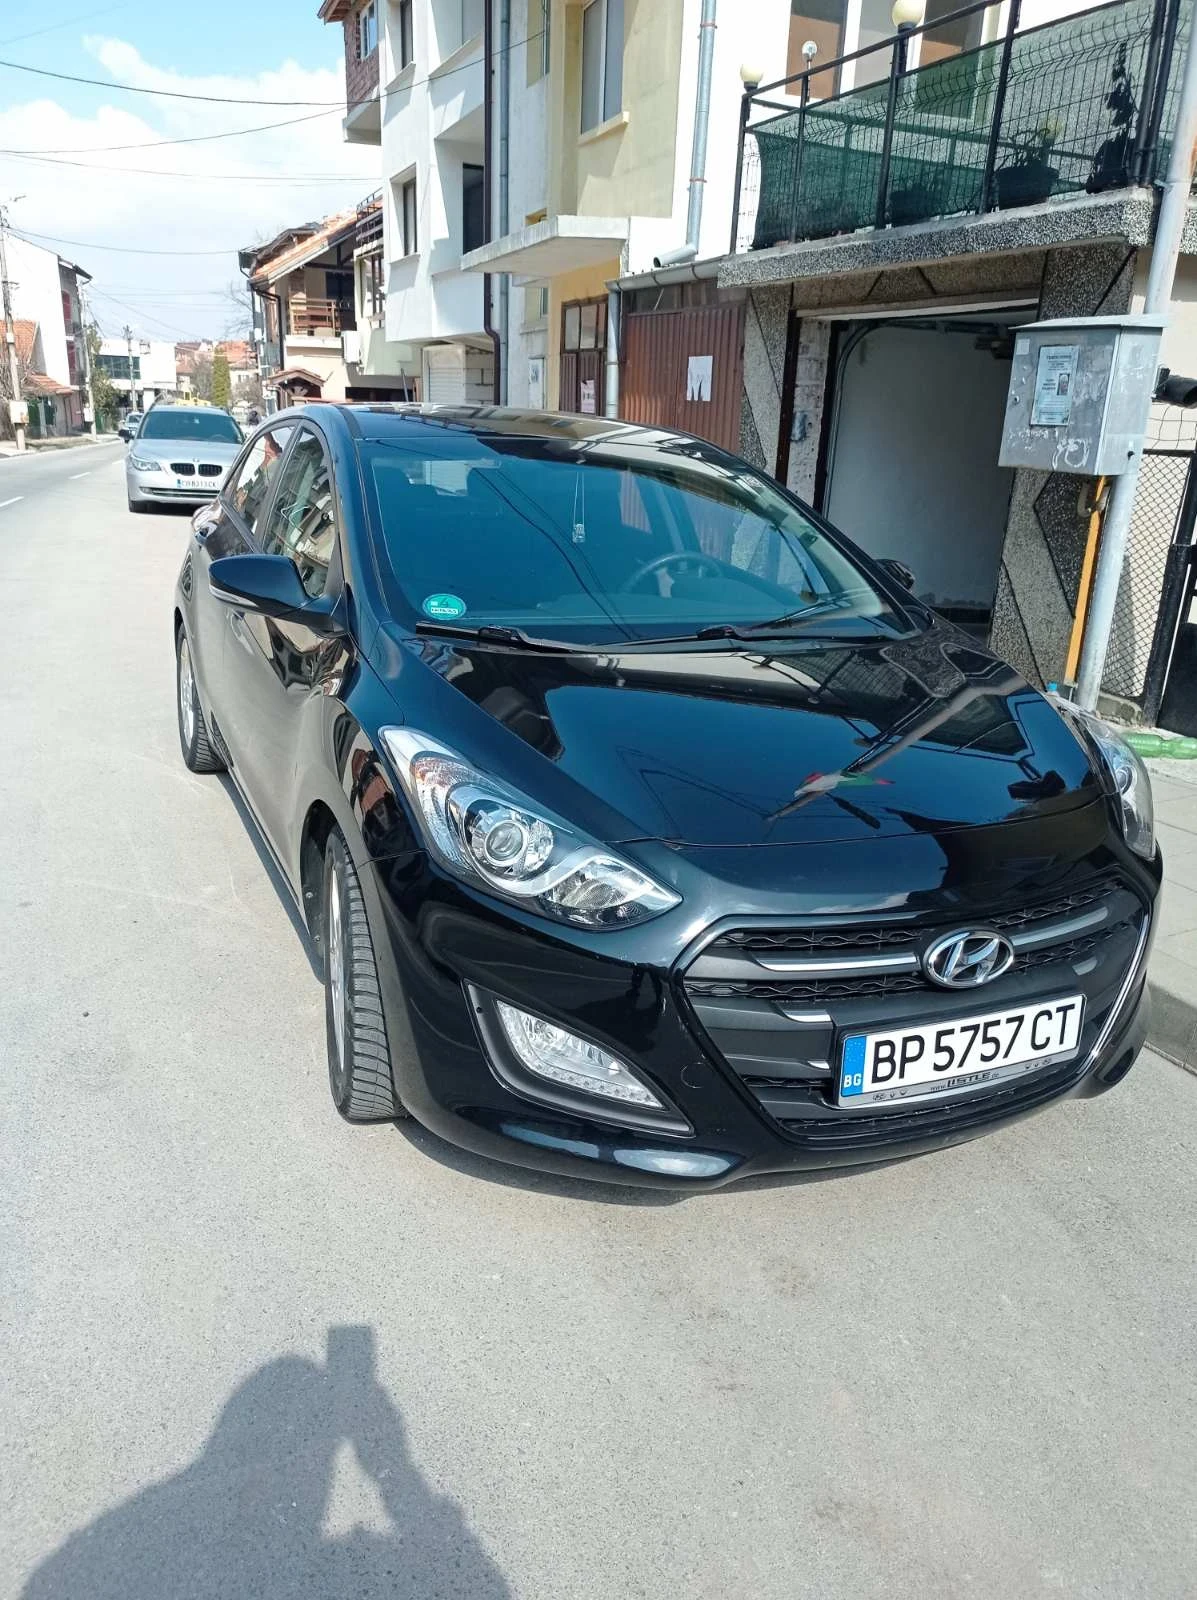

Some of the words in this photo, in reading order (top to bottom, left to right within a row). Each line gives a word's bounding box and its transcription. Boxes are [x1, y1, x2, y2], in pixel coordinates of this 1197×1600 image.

[871, 1034, 925, 1084] BP
[932, 1014, 1026, 1072] 5757
[1030, 1003, 1076, 1051] CT
[843, 1073, 862, 1087] BG
